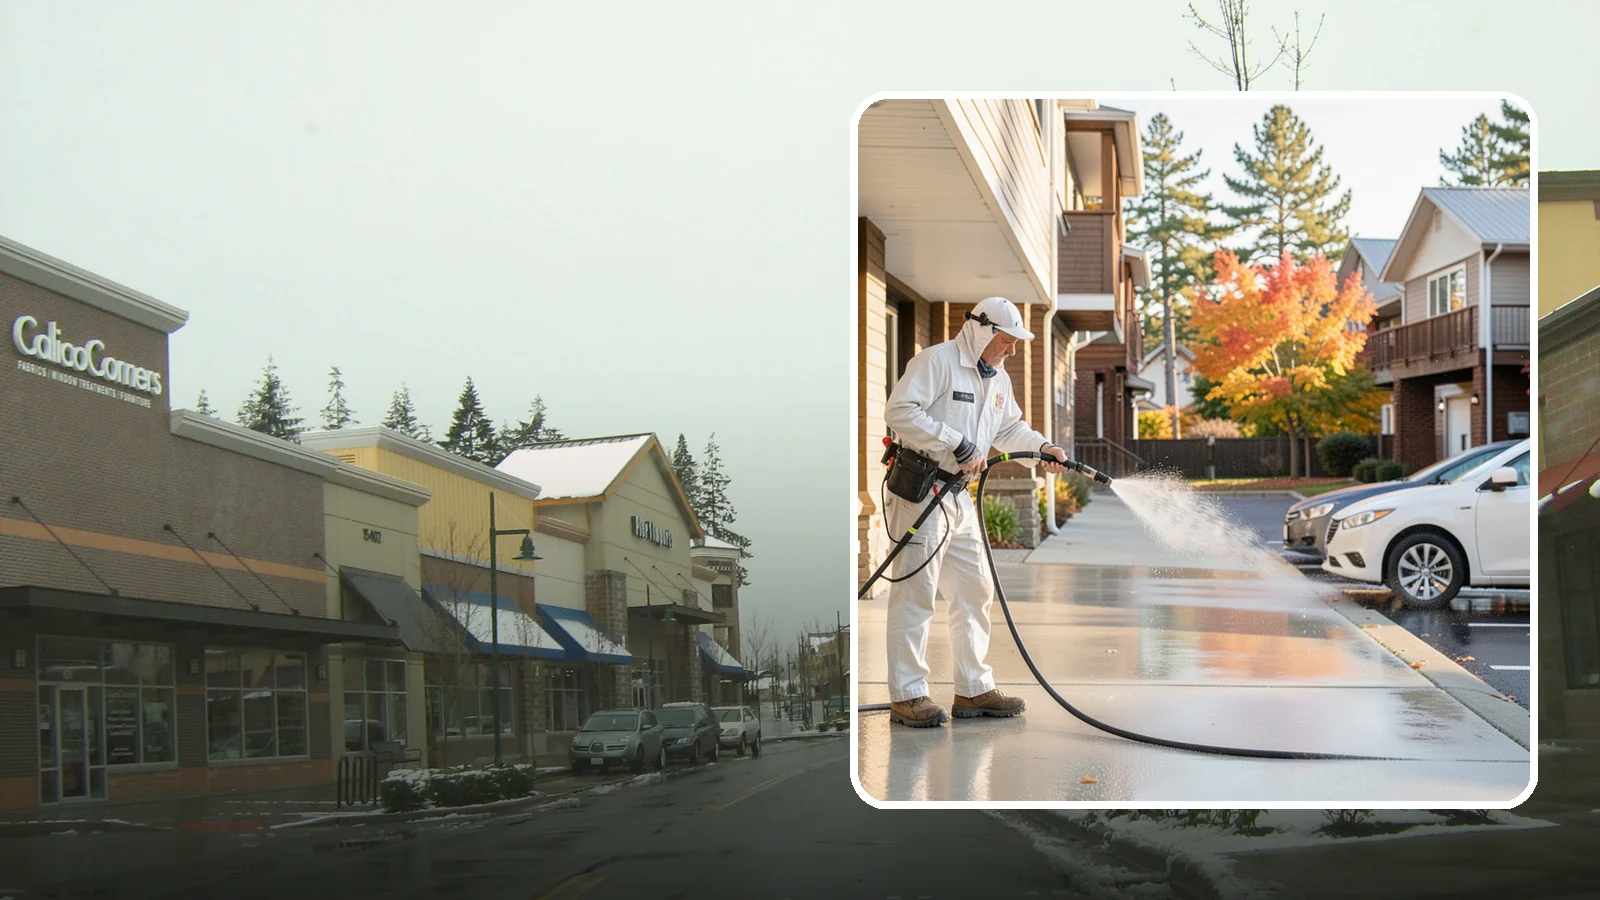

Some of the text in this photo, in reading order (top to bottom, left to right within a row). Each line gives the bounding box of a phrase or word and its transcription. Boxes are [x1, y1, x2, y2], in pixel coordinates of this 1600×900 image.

[17, 360, 47, 378] FABRICS
[51, 370, 78, 386] WINDOW
[79, 378, 117, 398] TREATMENTS
